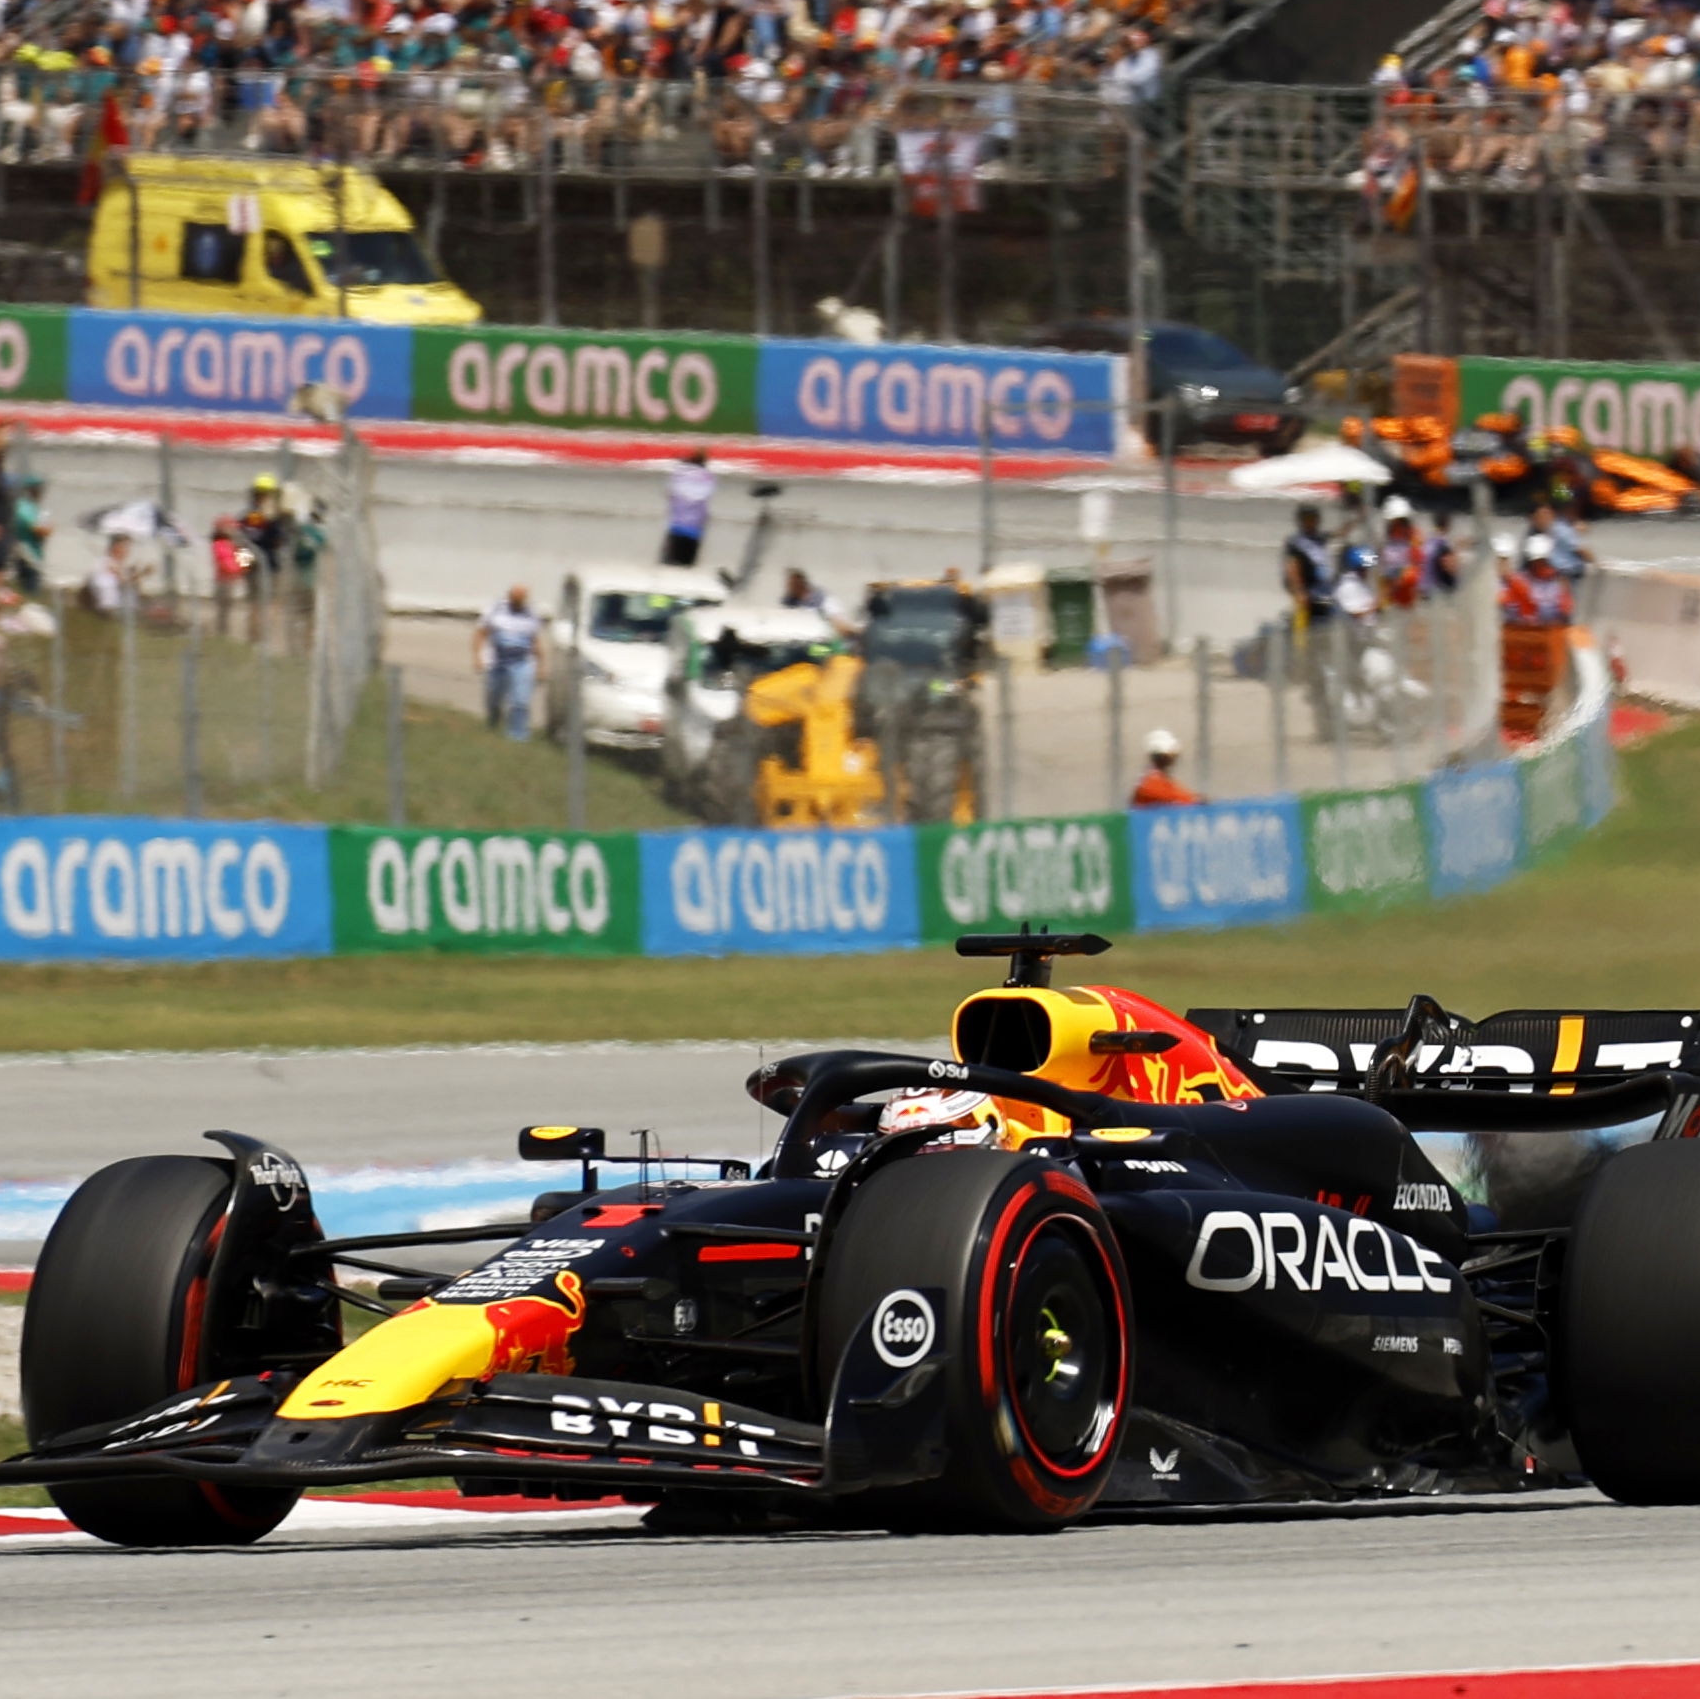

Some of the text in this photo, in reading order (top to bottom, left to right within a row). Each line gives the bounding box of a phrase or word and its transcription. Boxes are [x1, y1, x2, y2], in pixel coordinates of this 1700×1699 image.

[106, 325, 371, 405] aramco
[447, 340, 719, 423] aramco
[798, 356, 1075, 440] aramco
[366, 836, 609, 935] aramco
[670, 832, 889, 934] aramco
[939, 821, 1112, 926] aramco
[1393, 1182, 1453, 1213] HONDA
[1185, 1210, 1452, 1293] ORACLE
[883, 1310, 926, 1343] Esso
[1371, 1335, 1419, 1353] SIEMENS
